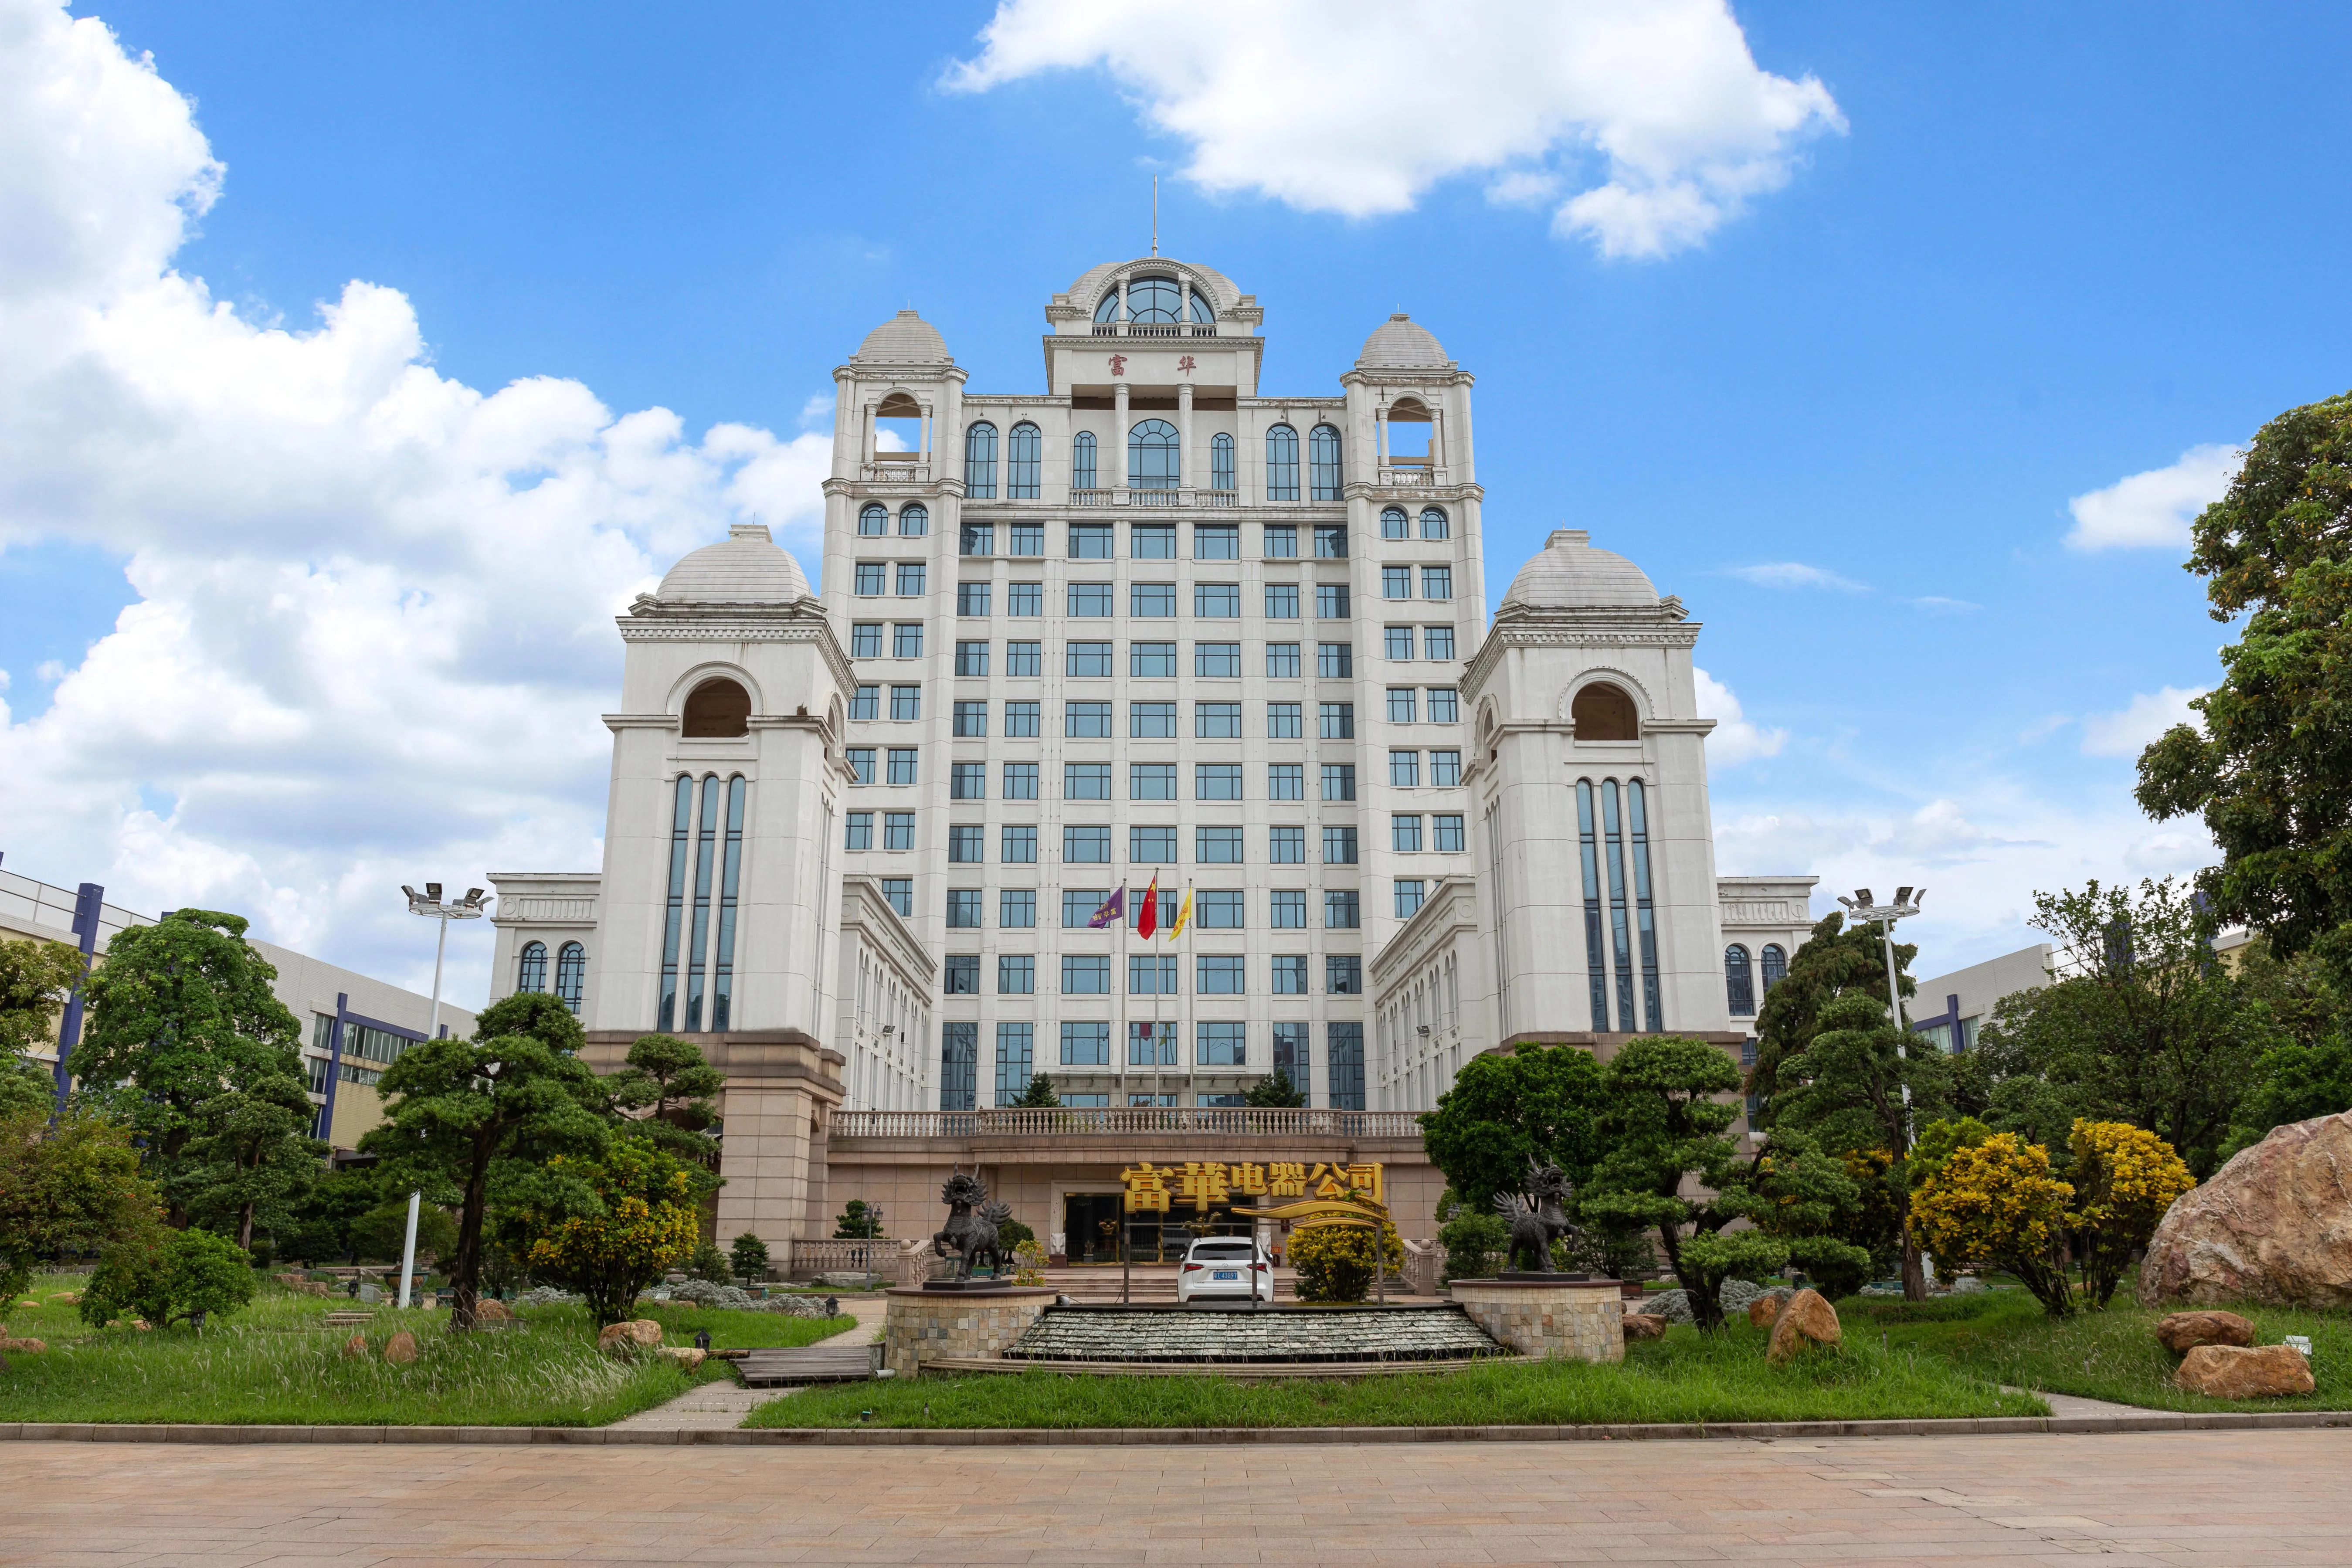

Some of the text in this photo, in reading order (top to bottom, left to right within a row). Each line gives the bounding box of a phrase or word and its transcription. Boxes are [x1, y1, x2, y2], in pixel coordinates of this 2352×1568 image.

[1120, 1162, 1388, 1214] 富華电器公司
